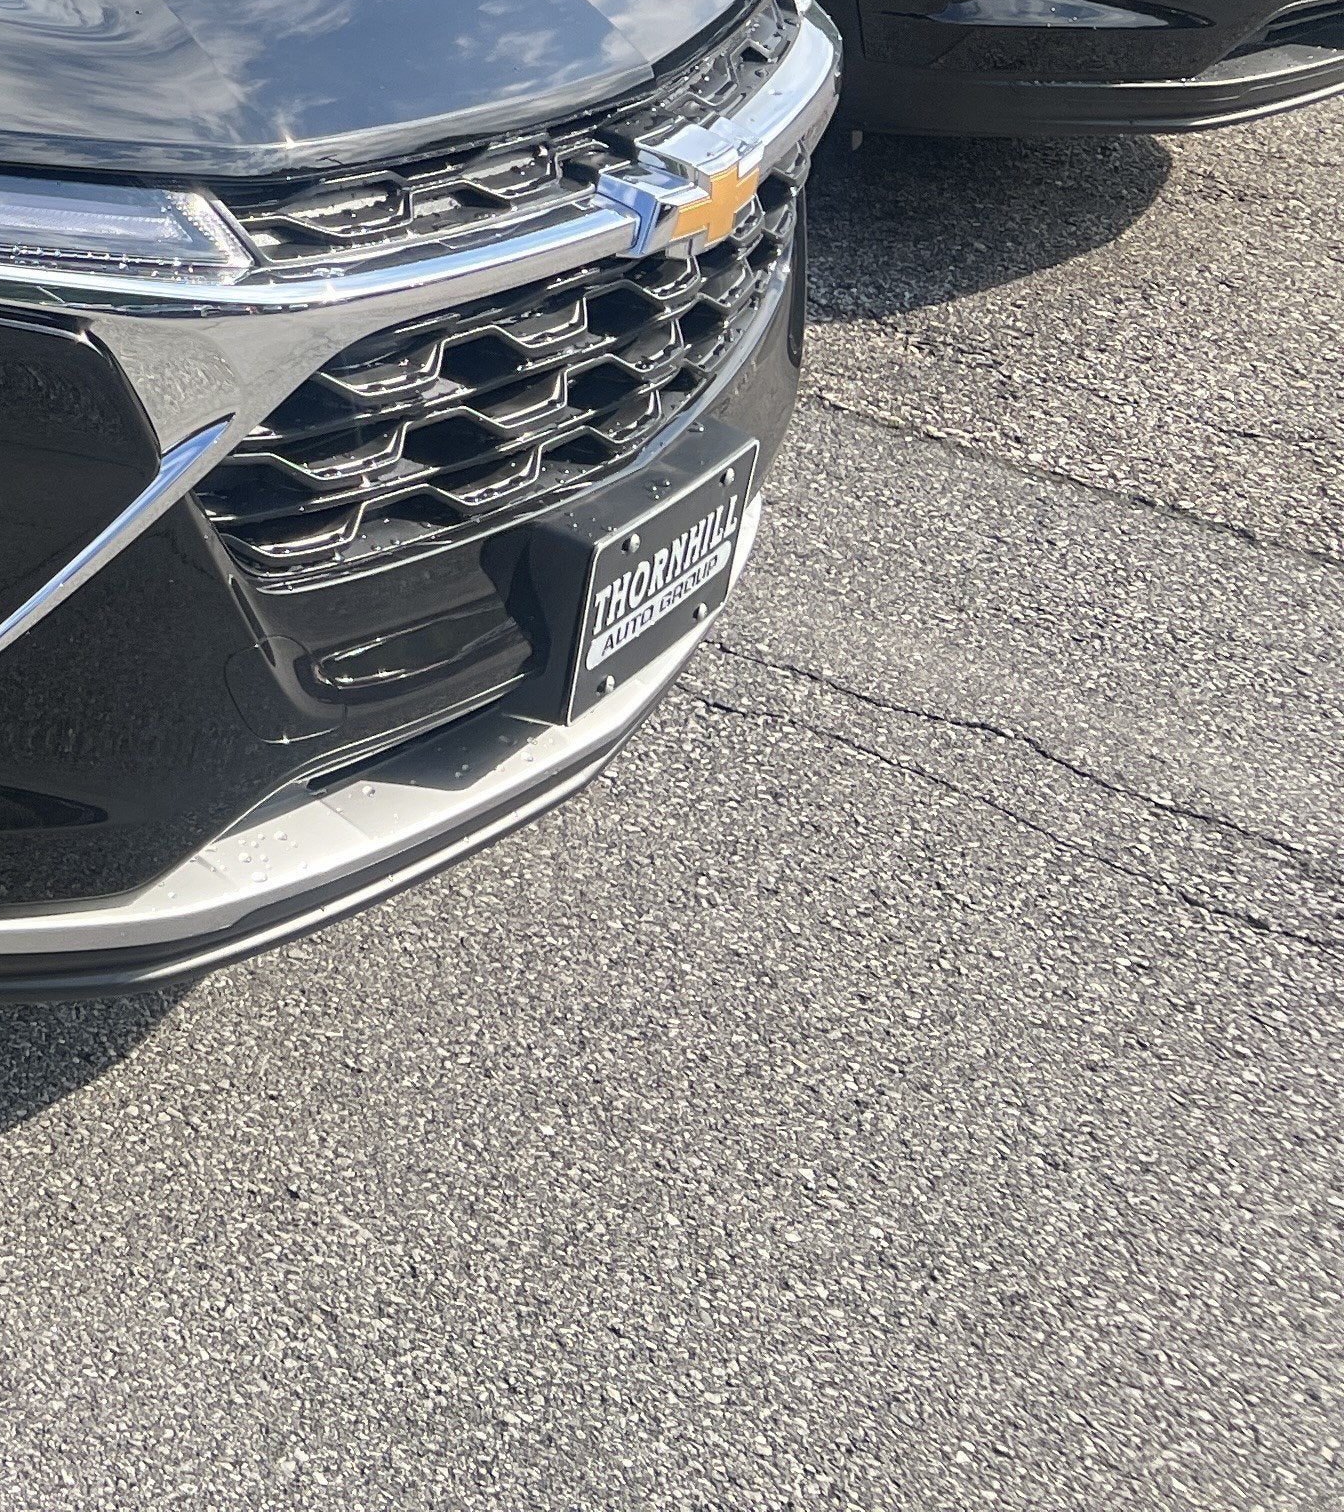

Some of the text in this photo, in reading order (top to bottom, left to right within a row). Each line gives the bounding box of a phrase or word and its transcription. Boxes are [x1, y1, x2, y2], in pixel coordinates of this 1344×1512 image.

[592, 494, 740, 636] THORNHILL
[600, 554, 719, 657] AUTO GROUP
